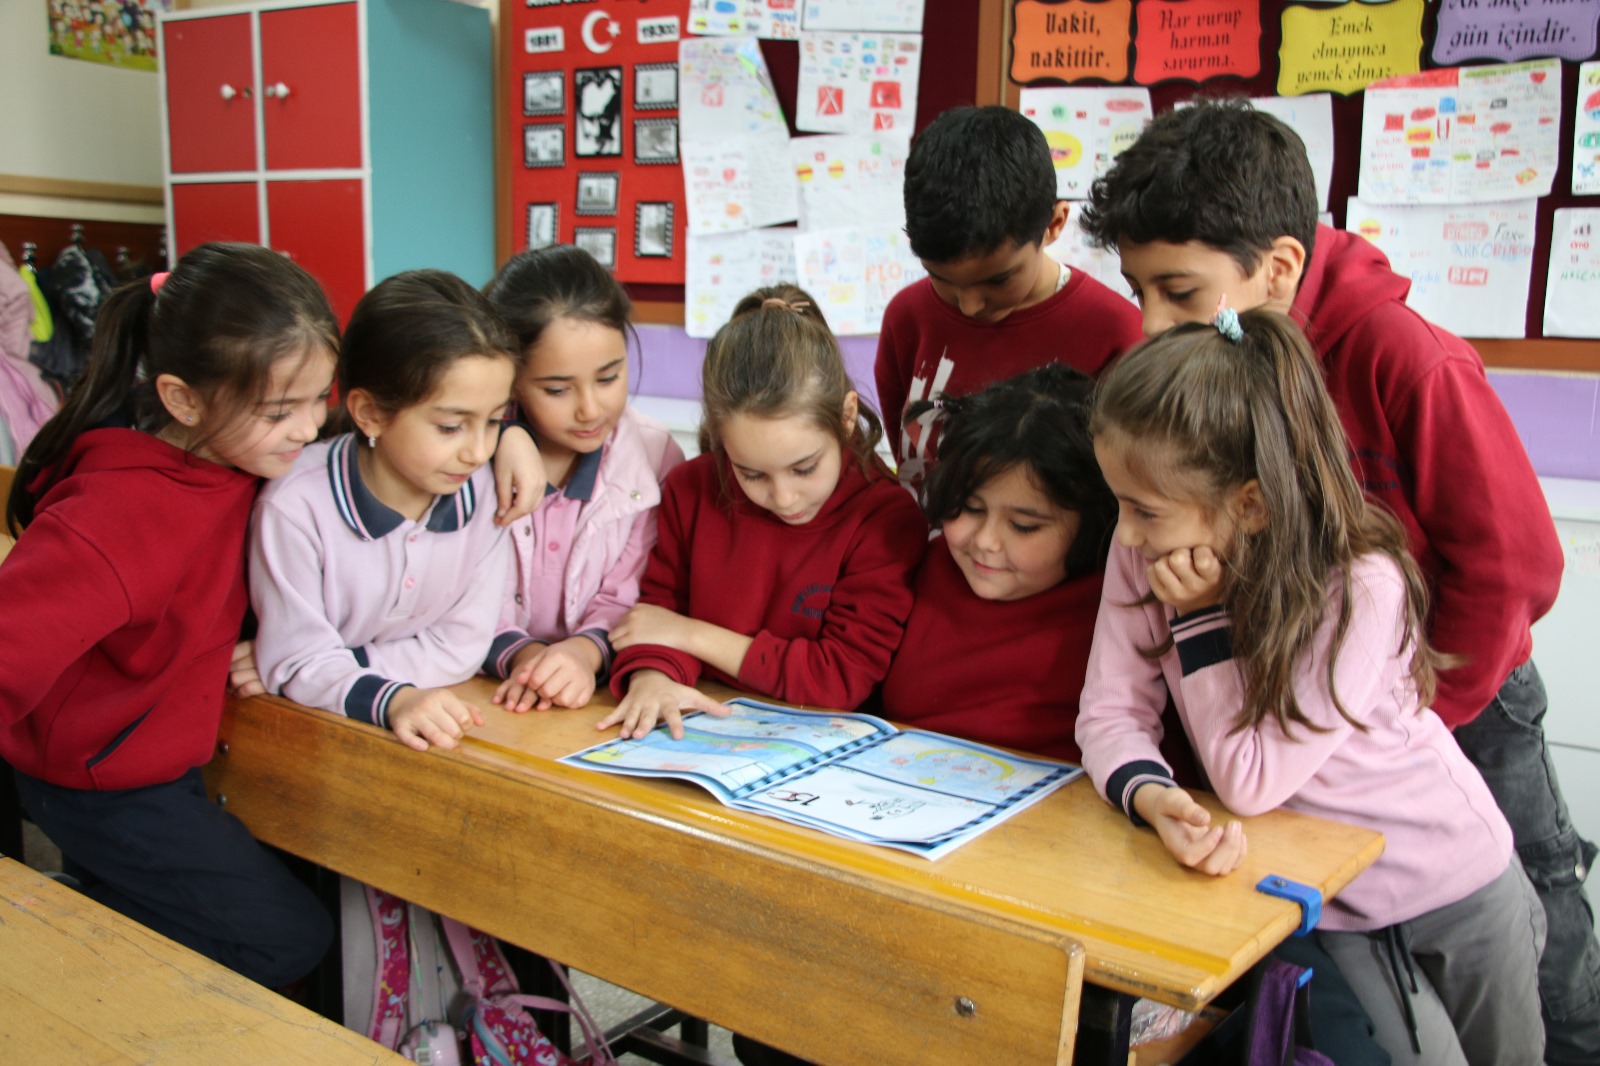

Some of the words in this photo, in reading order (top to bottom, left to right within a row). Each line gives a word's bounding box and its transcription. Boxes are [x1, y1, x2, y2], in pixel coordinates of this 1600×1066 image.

[1046, 11, 1101, 36] Vakit,
[1160, 9, 1190, 31] Har
[1196, 9, 1242, 29] vurup
[1327, 15, 1374, 37] Emek
[1170, 31, 1230, 50] harman
[1446, 24, 1488, 55] gün
[1497, 17, 1577, 51] içindir.
[1029, 45, 1112, 69] nakittir.
[1311, 41, 1387, 63] olmayınca
[1296, 67, 1343, 89] yemek
